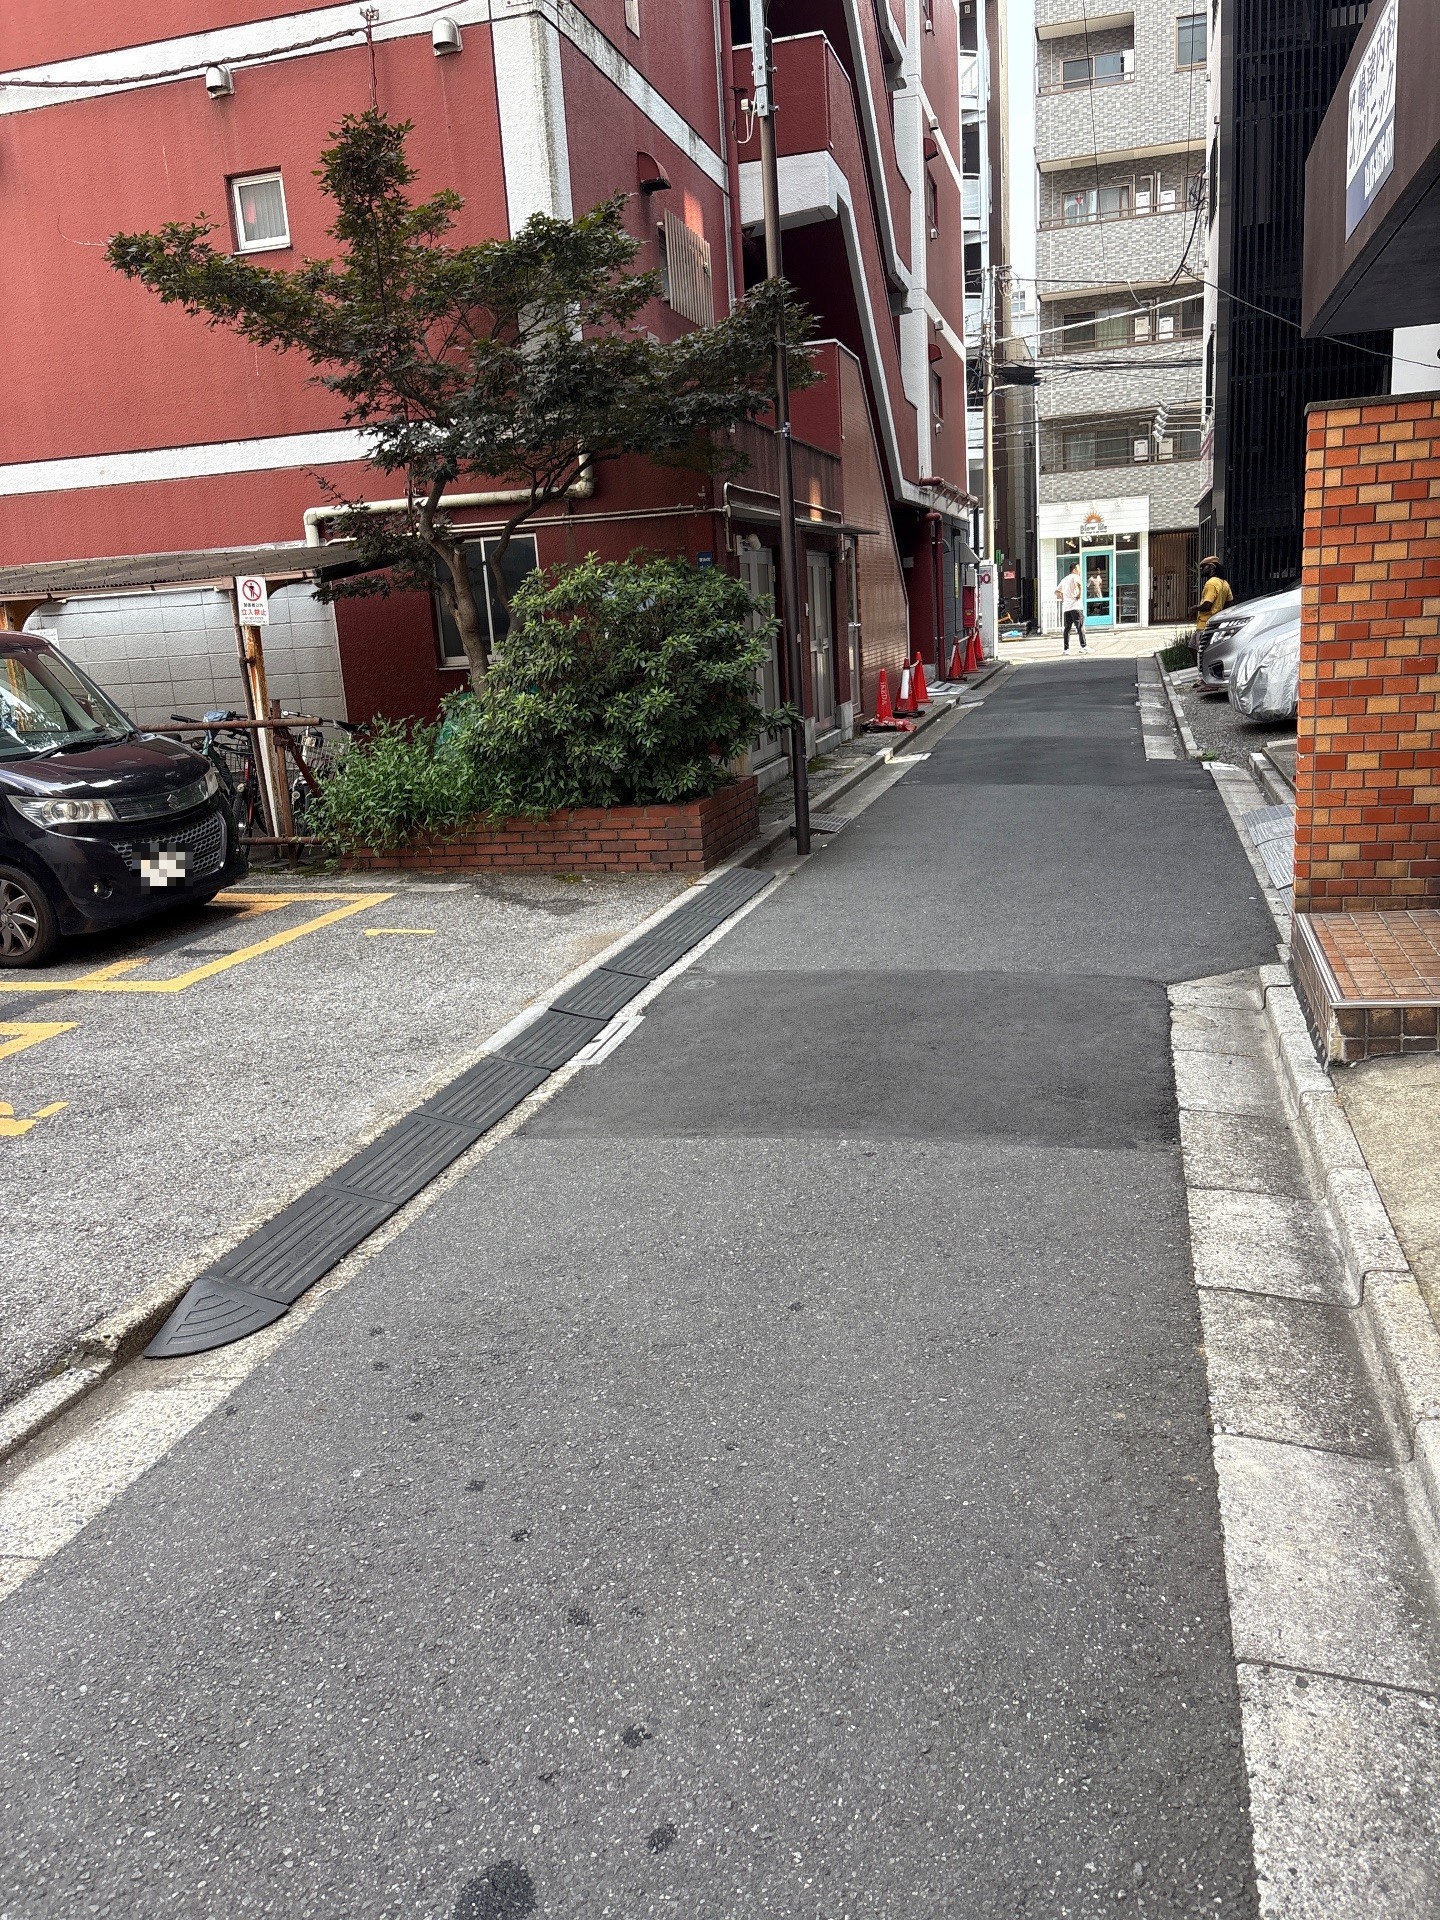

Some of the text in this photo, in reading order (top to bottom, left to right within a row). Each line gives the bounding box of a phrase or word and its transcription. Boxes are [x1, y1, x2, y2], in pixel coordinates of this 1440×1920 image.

[1356, 60, 1395, 168] クリニック
